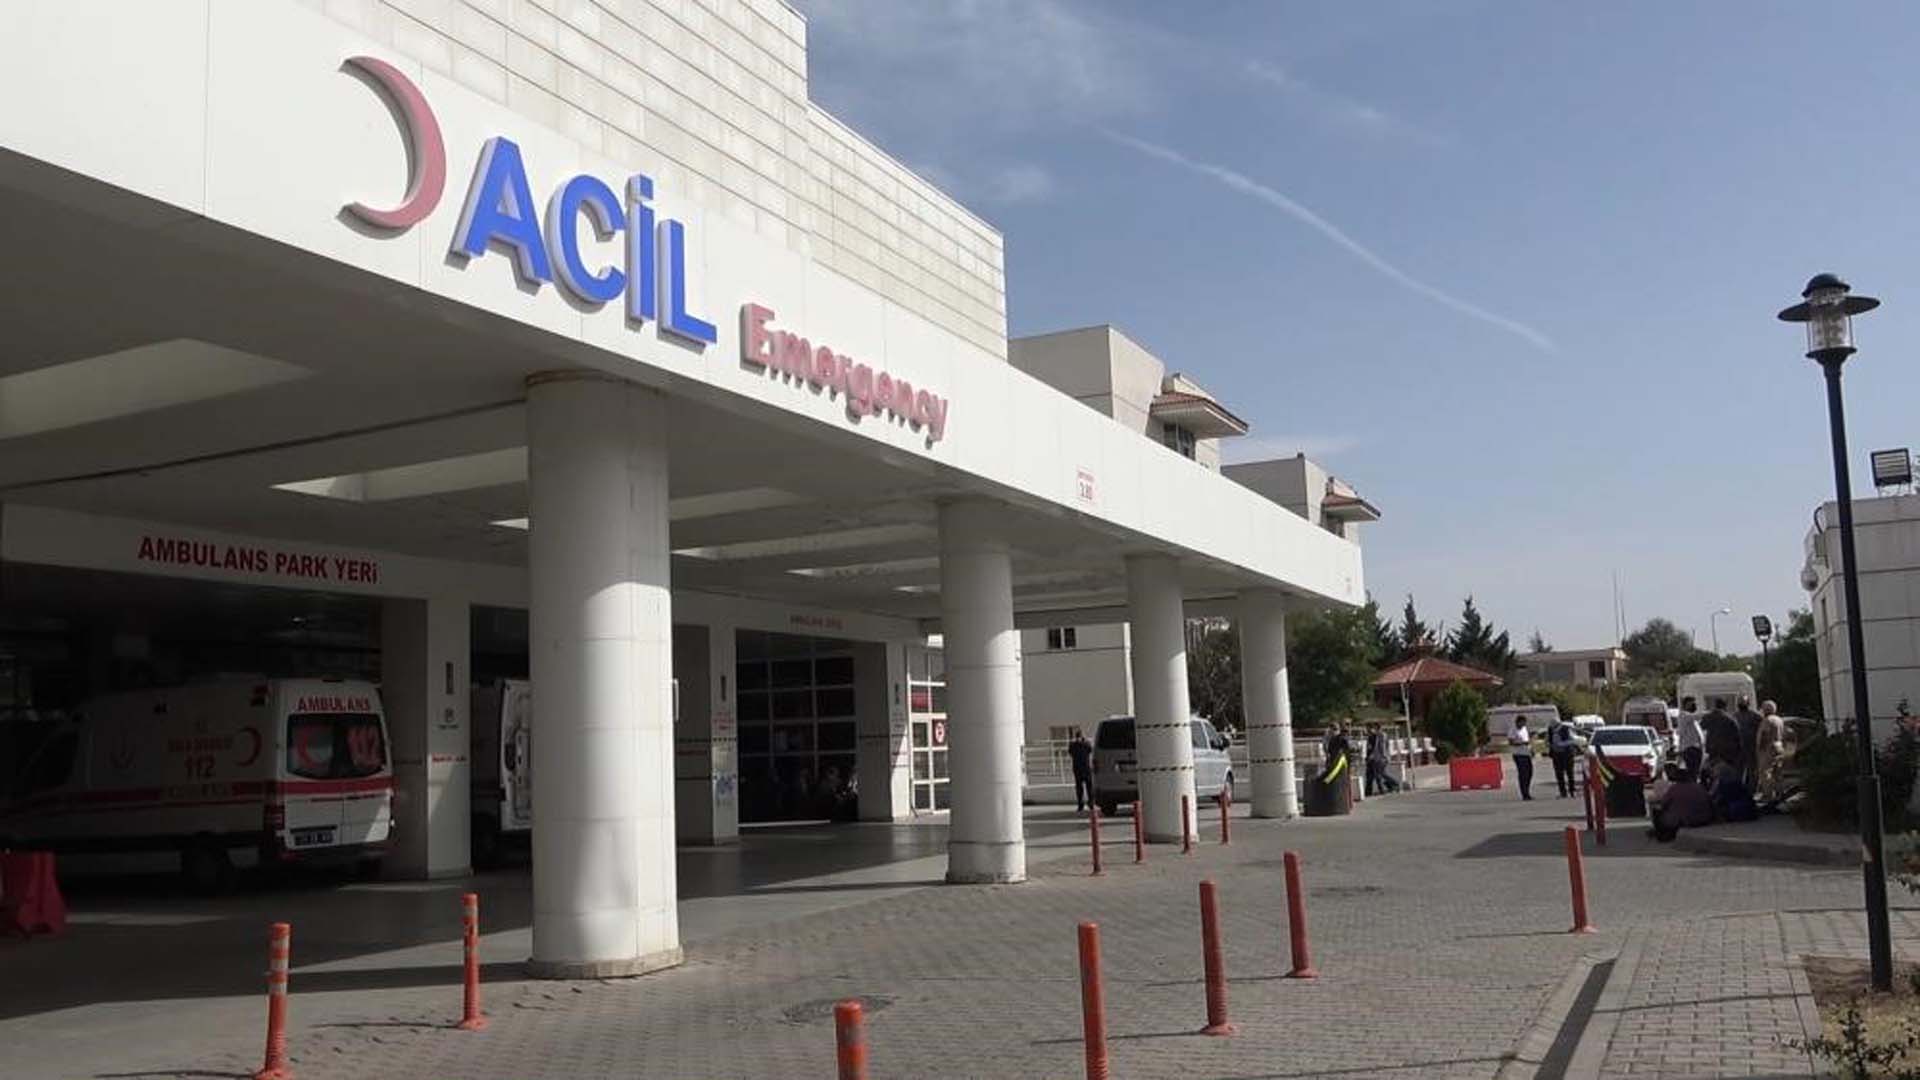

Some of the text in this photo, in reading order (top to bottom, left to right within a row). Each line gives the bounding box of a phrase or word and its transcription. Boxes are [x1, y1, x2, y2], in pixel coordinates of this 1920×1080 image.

[449, 135, 718, 349] ACİL
[740, 302, 948, 444] Emergency
[138, 536, 269, 573] AMBULANS
[275, 552, 328, 579] PARK
[297, 694, 371, 712] AMBULANS
